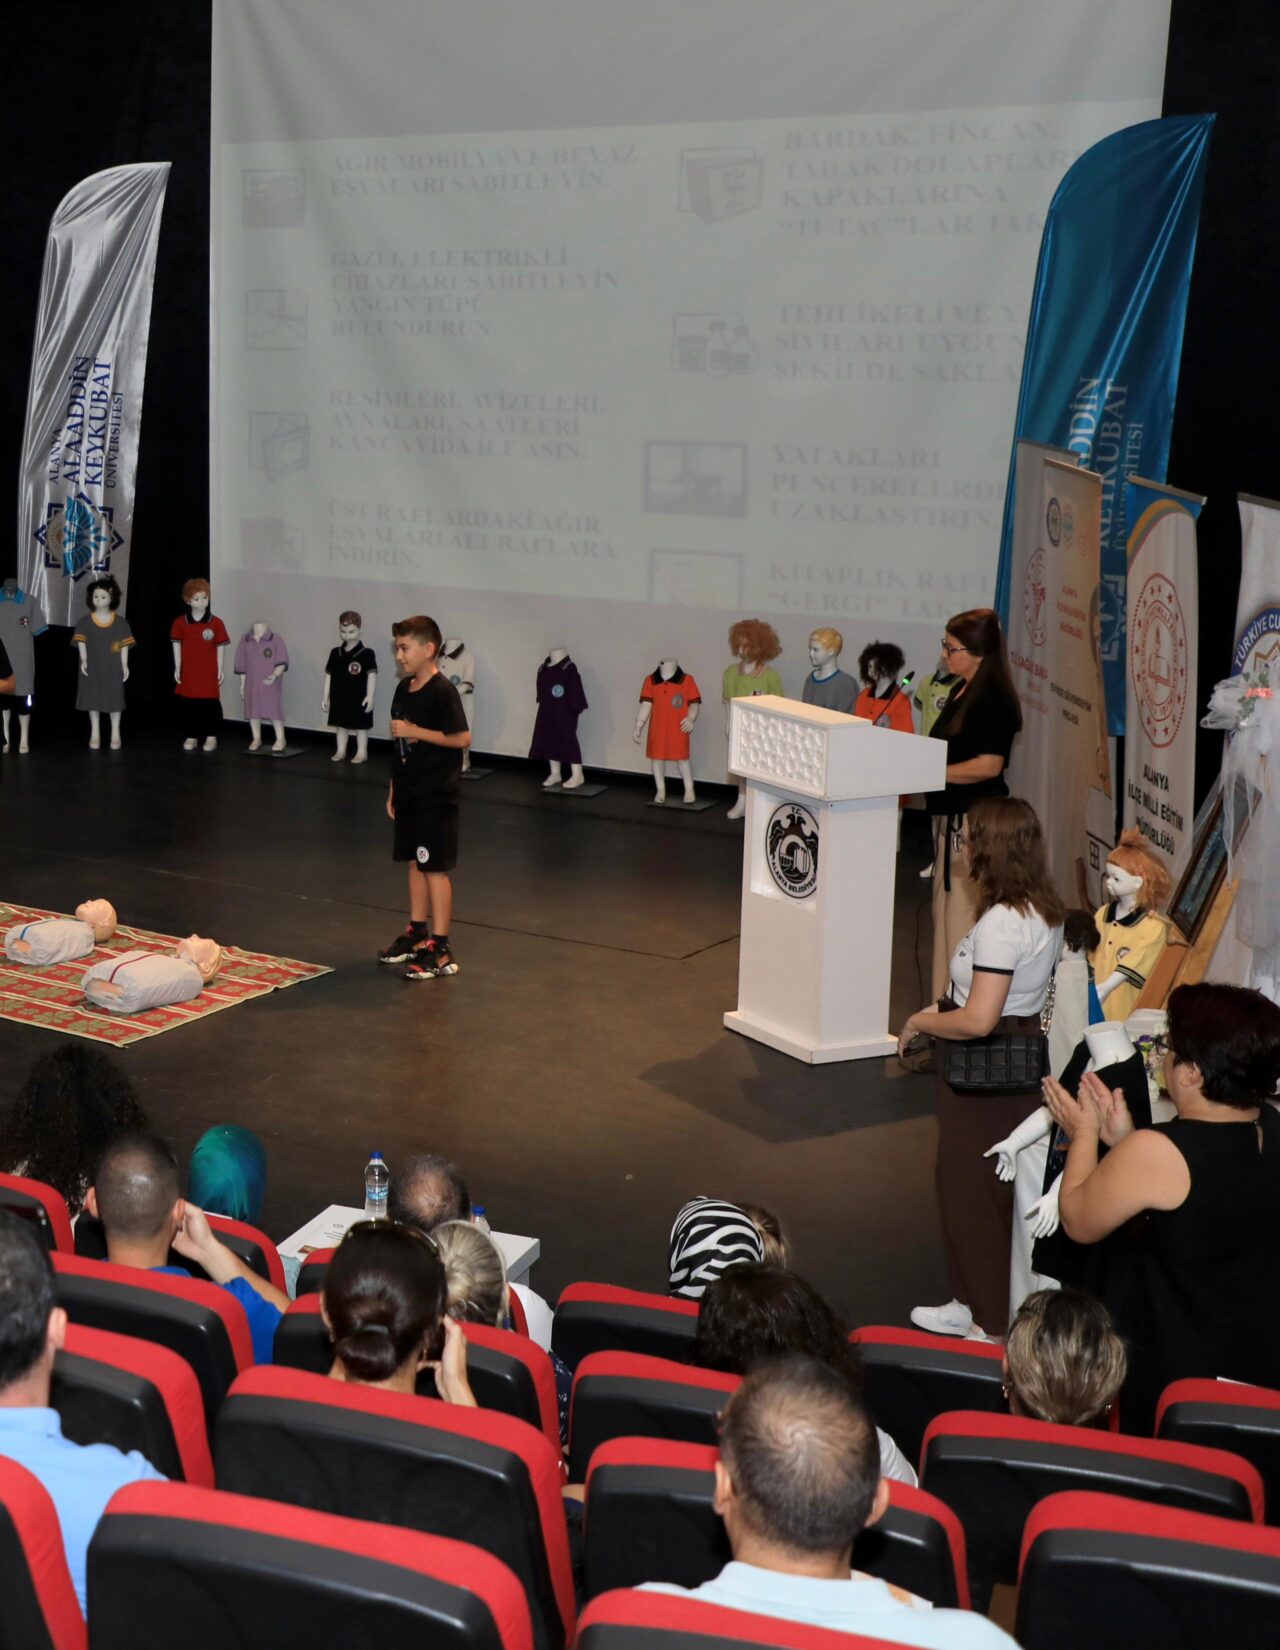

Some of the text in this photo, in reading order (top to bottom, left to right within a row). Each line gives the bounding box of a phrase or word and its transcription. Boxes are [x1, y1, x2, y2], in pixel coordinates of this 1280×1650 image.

[551, 144, 638, 165] BEYAZ
[784, 149, 1080, 180] TABAK DOLAPLAR
[782, 183, 1009, 208] KAPAKLARINA
[985, 212, 1042, 234] TAK
[911, 362, 1019, 383] SAKLA
[63, 356, 91, 485] ALAADDİN
[84, 357, 112, 487] KEYKUBAT
[49, 428, 63, 484] ALANYA
[771, 444, 941, 469] YATAKLARI
[1234, 615, 1268, 668] TÜRKİYE
